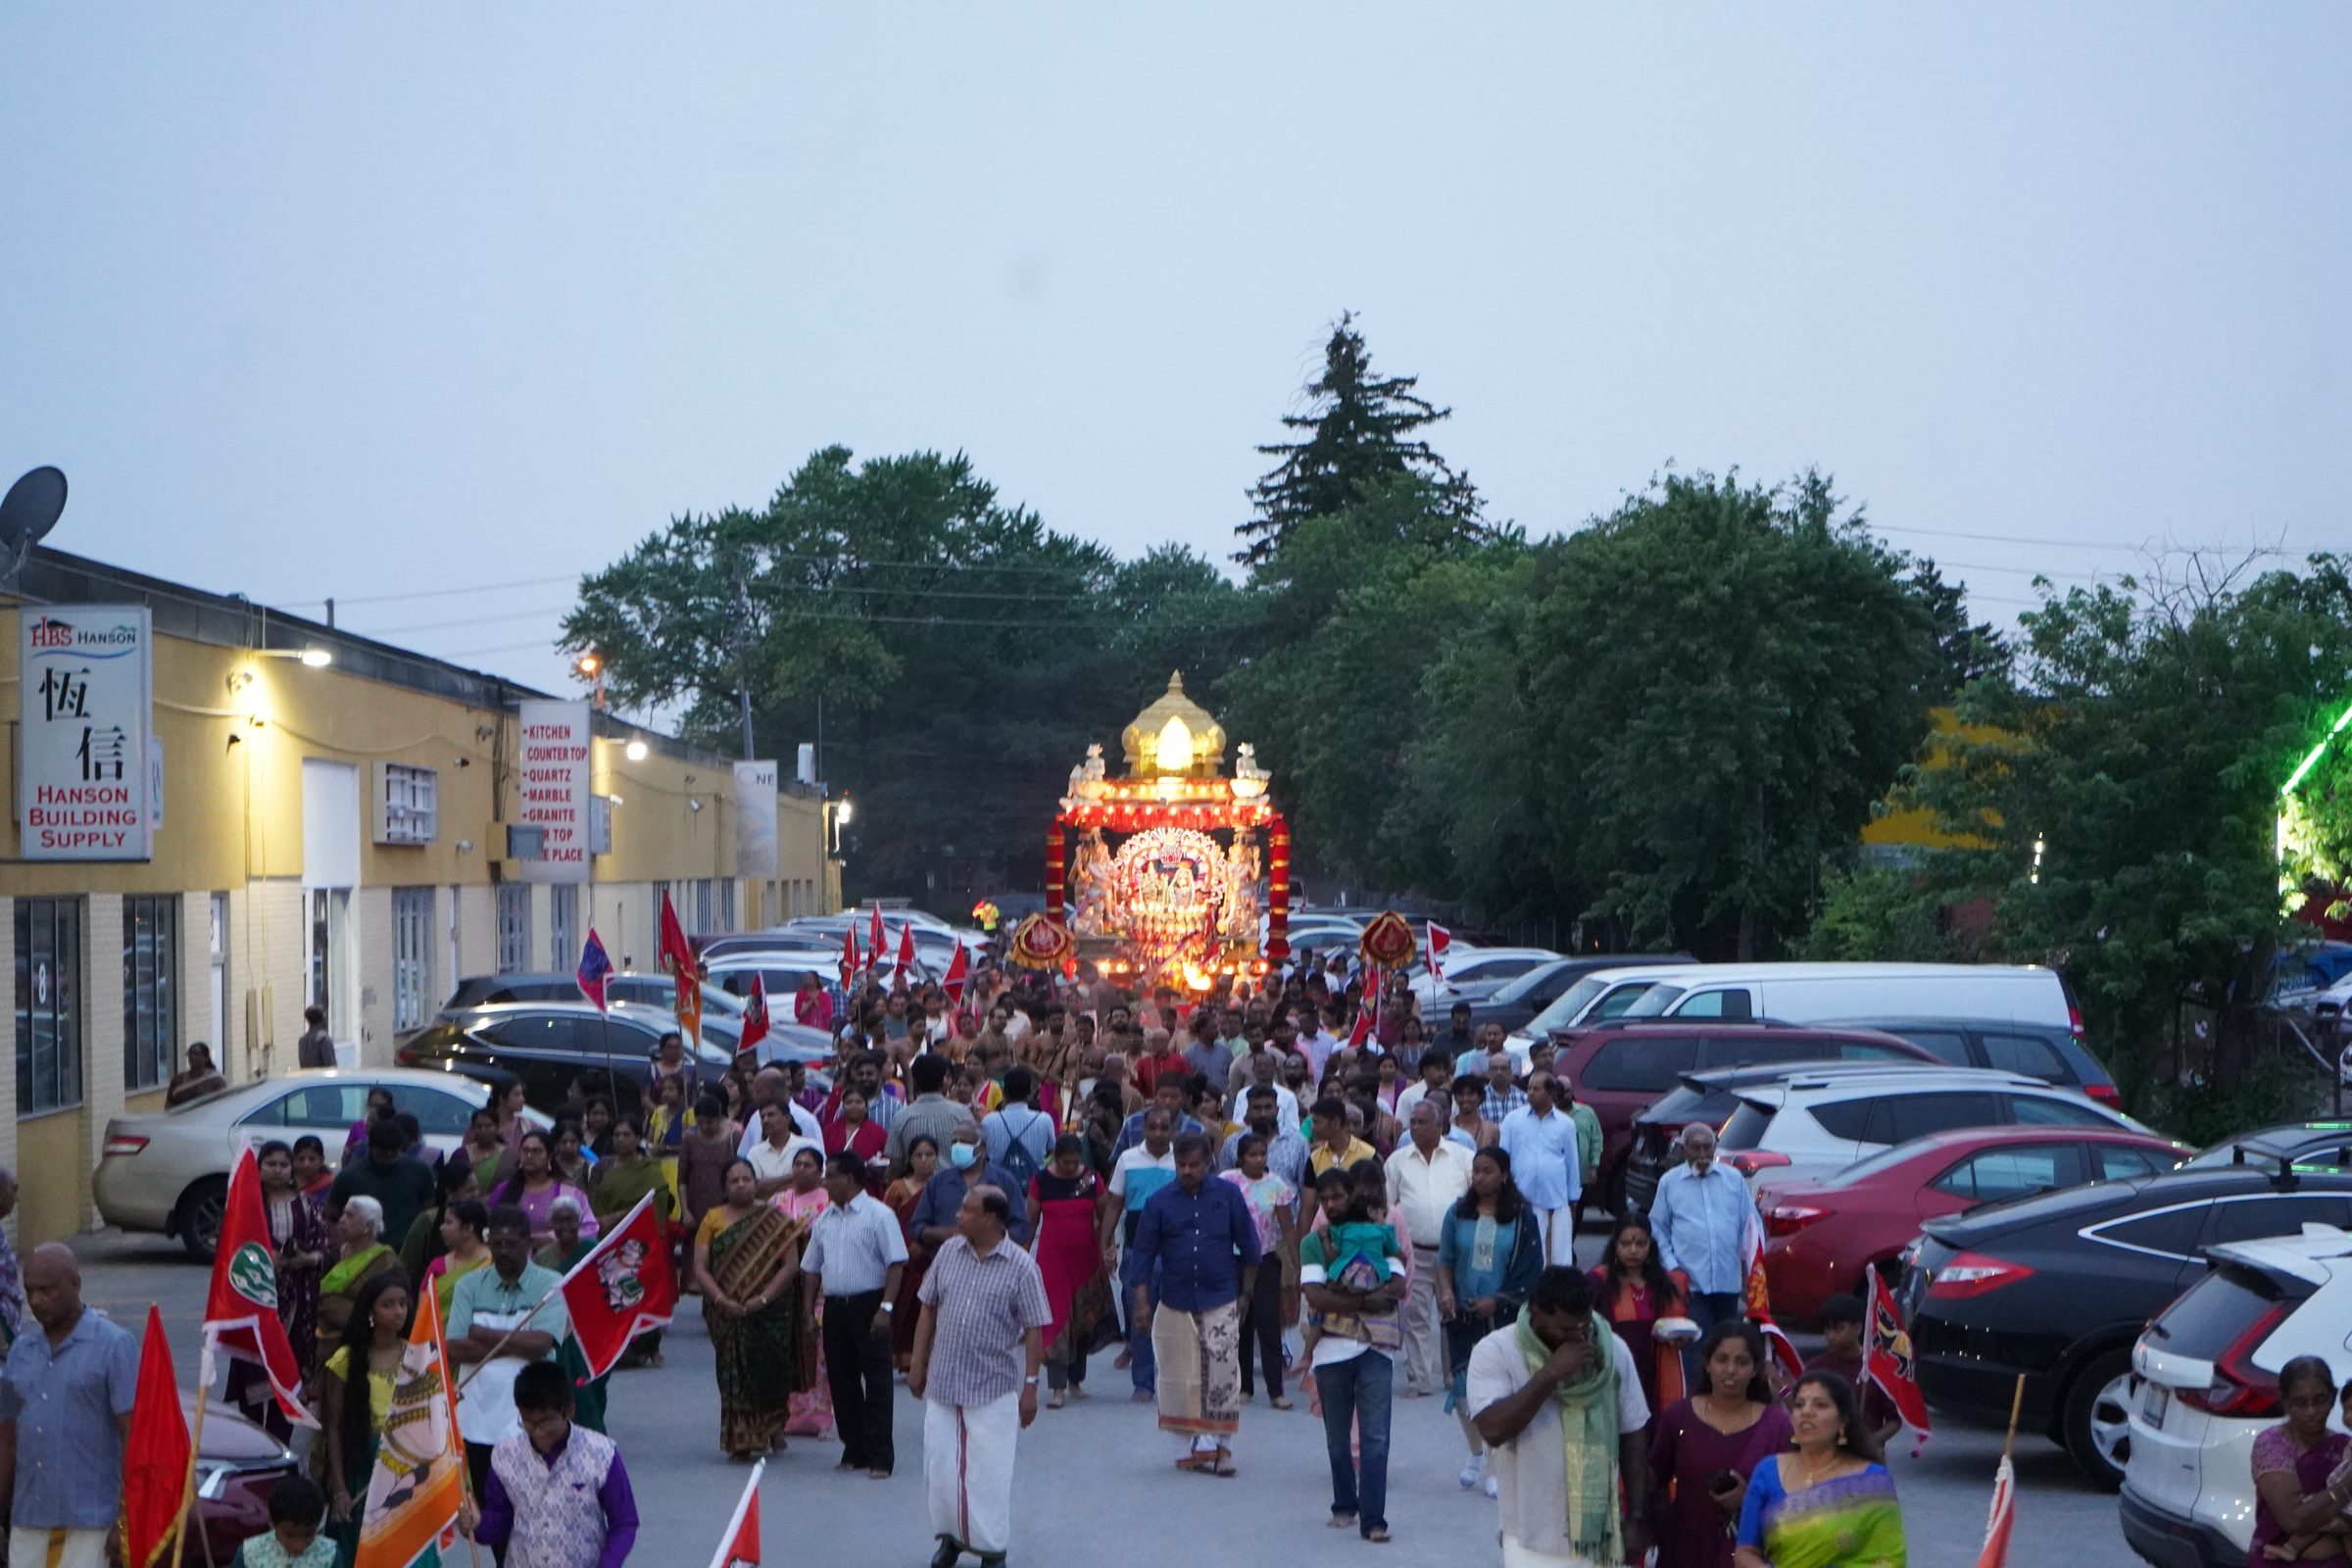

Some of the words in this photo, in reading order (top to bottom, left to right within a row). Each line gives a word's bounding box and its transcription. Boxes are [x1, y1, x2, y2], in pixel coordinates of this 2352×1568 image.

[31, 615, 73, 647] HBS
[77, 630, 136, 644] HANSON
[529, 725, 570, 740] KITCHEN
[527, 746, 568, 761] COUNTER
[570, 746, 587, 761] TOP
[529, 768, 571, 782] QUARTZ
[37, 785, 128, 804] HANSON
[529, 788, 571, 803] MARBLE
[29, 808, 136, 826] BUILDING
[529, 808, 575, 822] GRANITE
[41, 830, 125, 848] SUPPLY
[554, 828, 572, 842] TOP
[553, 848, 583, 862] PLACE
[38, 962, 46, 1004] 8
